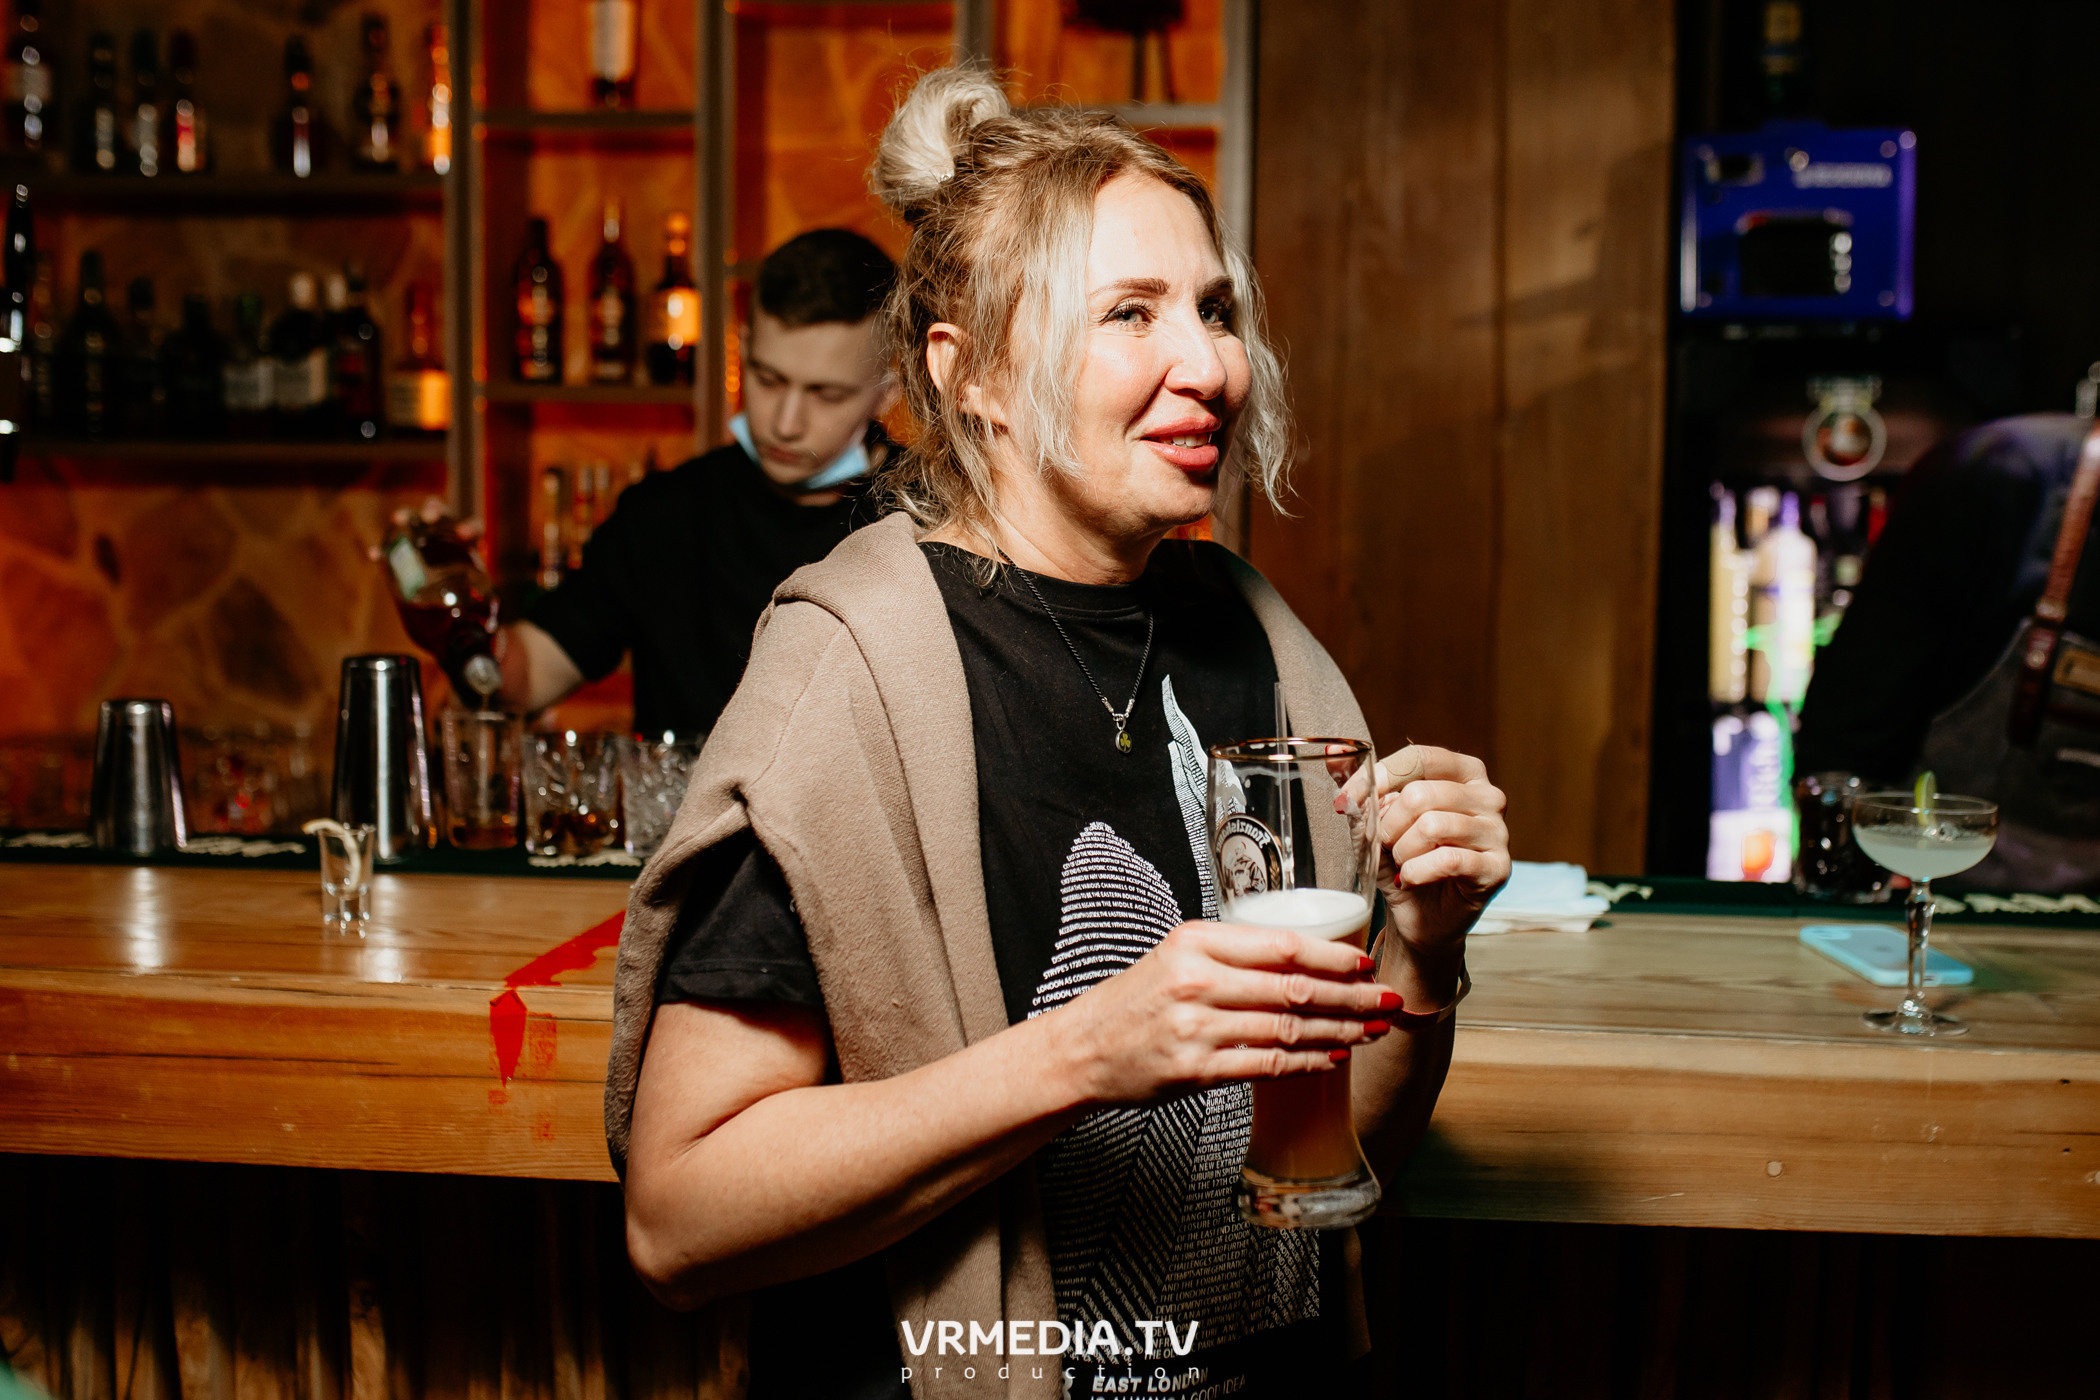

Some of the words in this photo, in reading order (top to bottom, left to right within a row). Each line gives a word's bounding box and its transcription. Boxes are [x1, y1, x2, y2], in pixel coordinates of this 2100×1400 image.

[1036, 978, 1064, 995] LONDON
[1207, 1086, 1230, 1099] STRONG
[1230, 1083, 1242, 1095] PULL
[1206, 1096, 1226, 1108] RURAL
[1227, 1091, 1244, 1104] POOR
[1205, 1104, 1225, 1116] OTHER
[1225, 1101, 1241, 1111] PARTS
[1203, 1114, 1221, 1126] LAND
[1201, 1123, 1221, 1135] WAVES
[1198, 1133, 1216, 1146] FROM
[1216, 1129, 1240, 1142] FURTHER
[1197, 1141, 1225, 1155] NOTABLY
[1199, 1160, 1215, 1172] NEW
[1204, 1185, 1233, 1200] WEAVERS
[1092, 1375, 1143, 1393] EAST
[1147, 1367, 1208, 1393] LONDON
